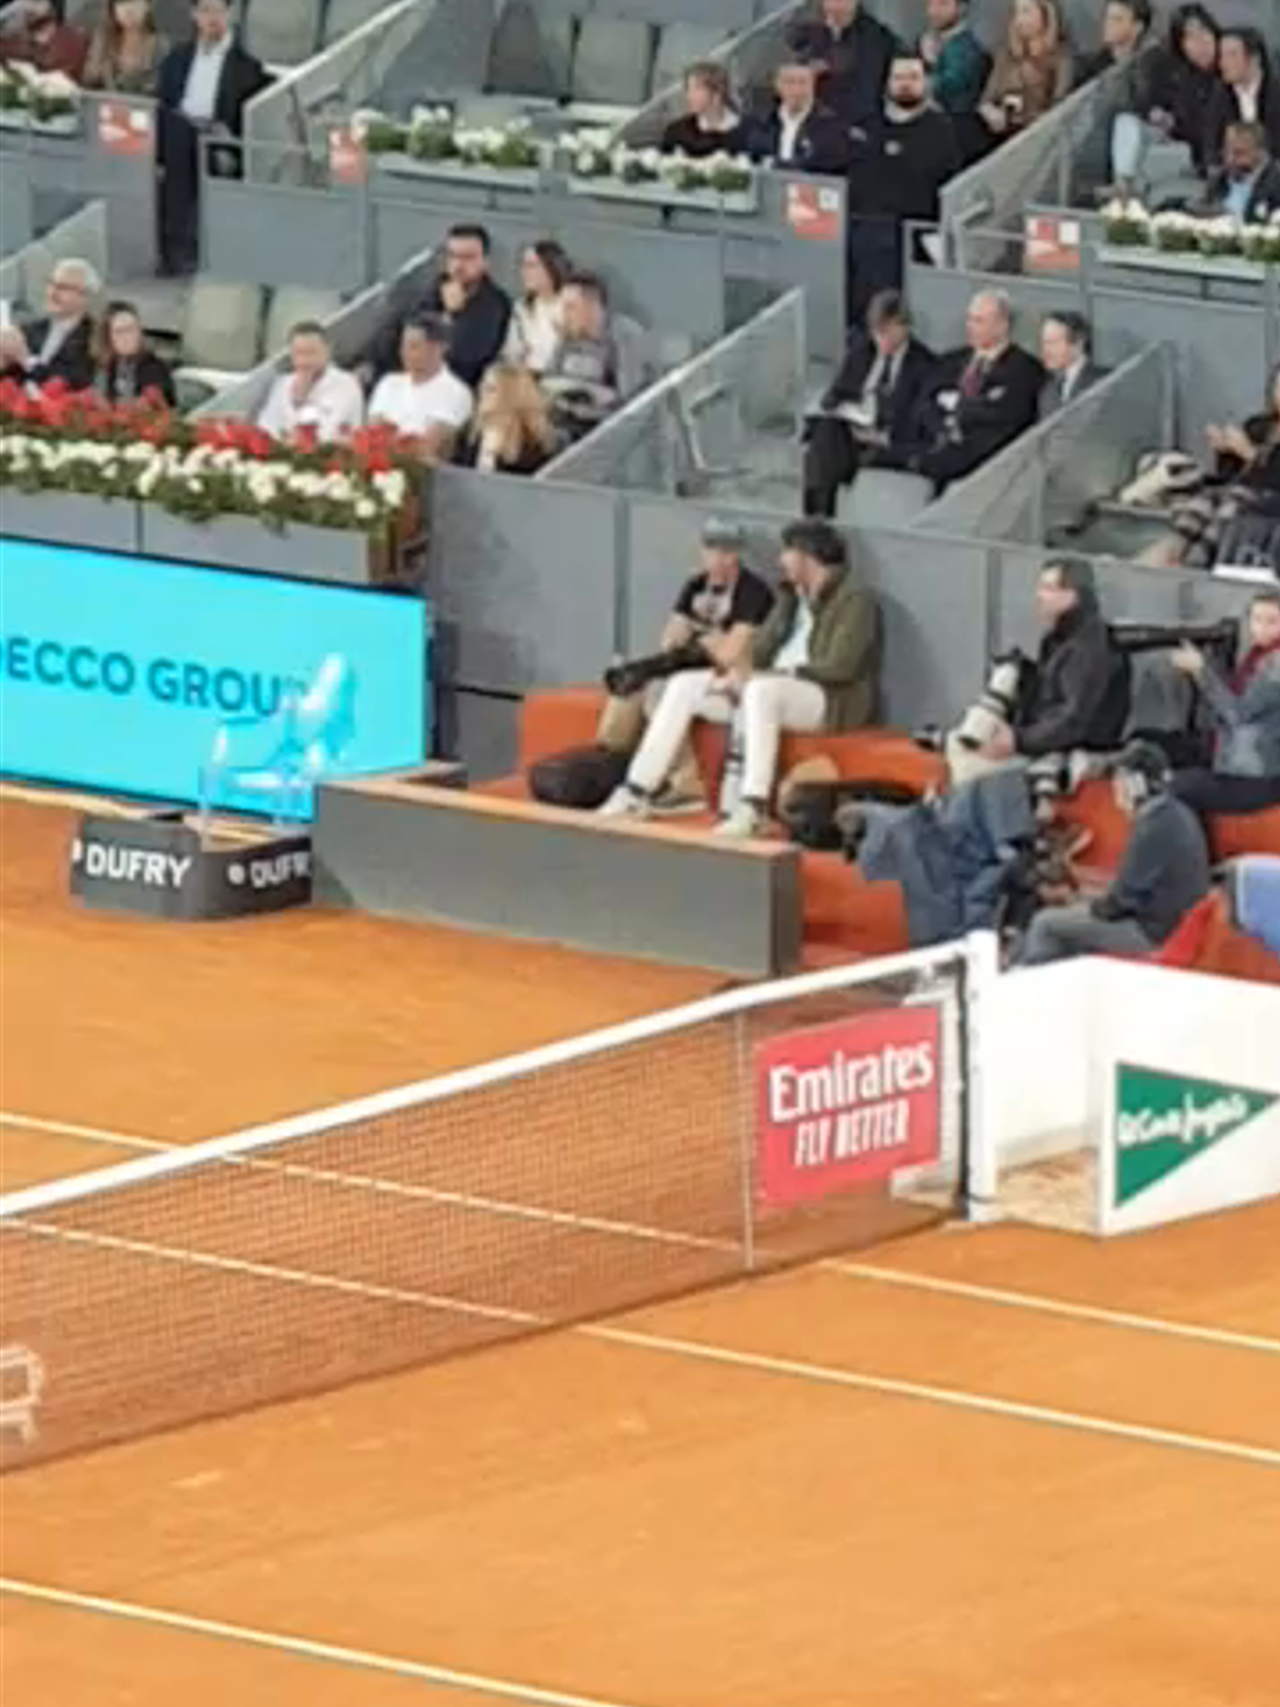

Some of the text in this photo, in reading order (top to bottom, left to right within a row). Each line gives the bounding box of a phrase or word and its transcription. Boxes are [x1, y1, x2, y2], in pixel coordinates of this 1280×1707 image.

[0, 635, 308, 716] ECCO GROU
[85, 843, 192, 888] DUFRY
[768, 1041, 935, 1123] Emirates
